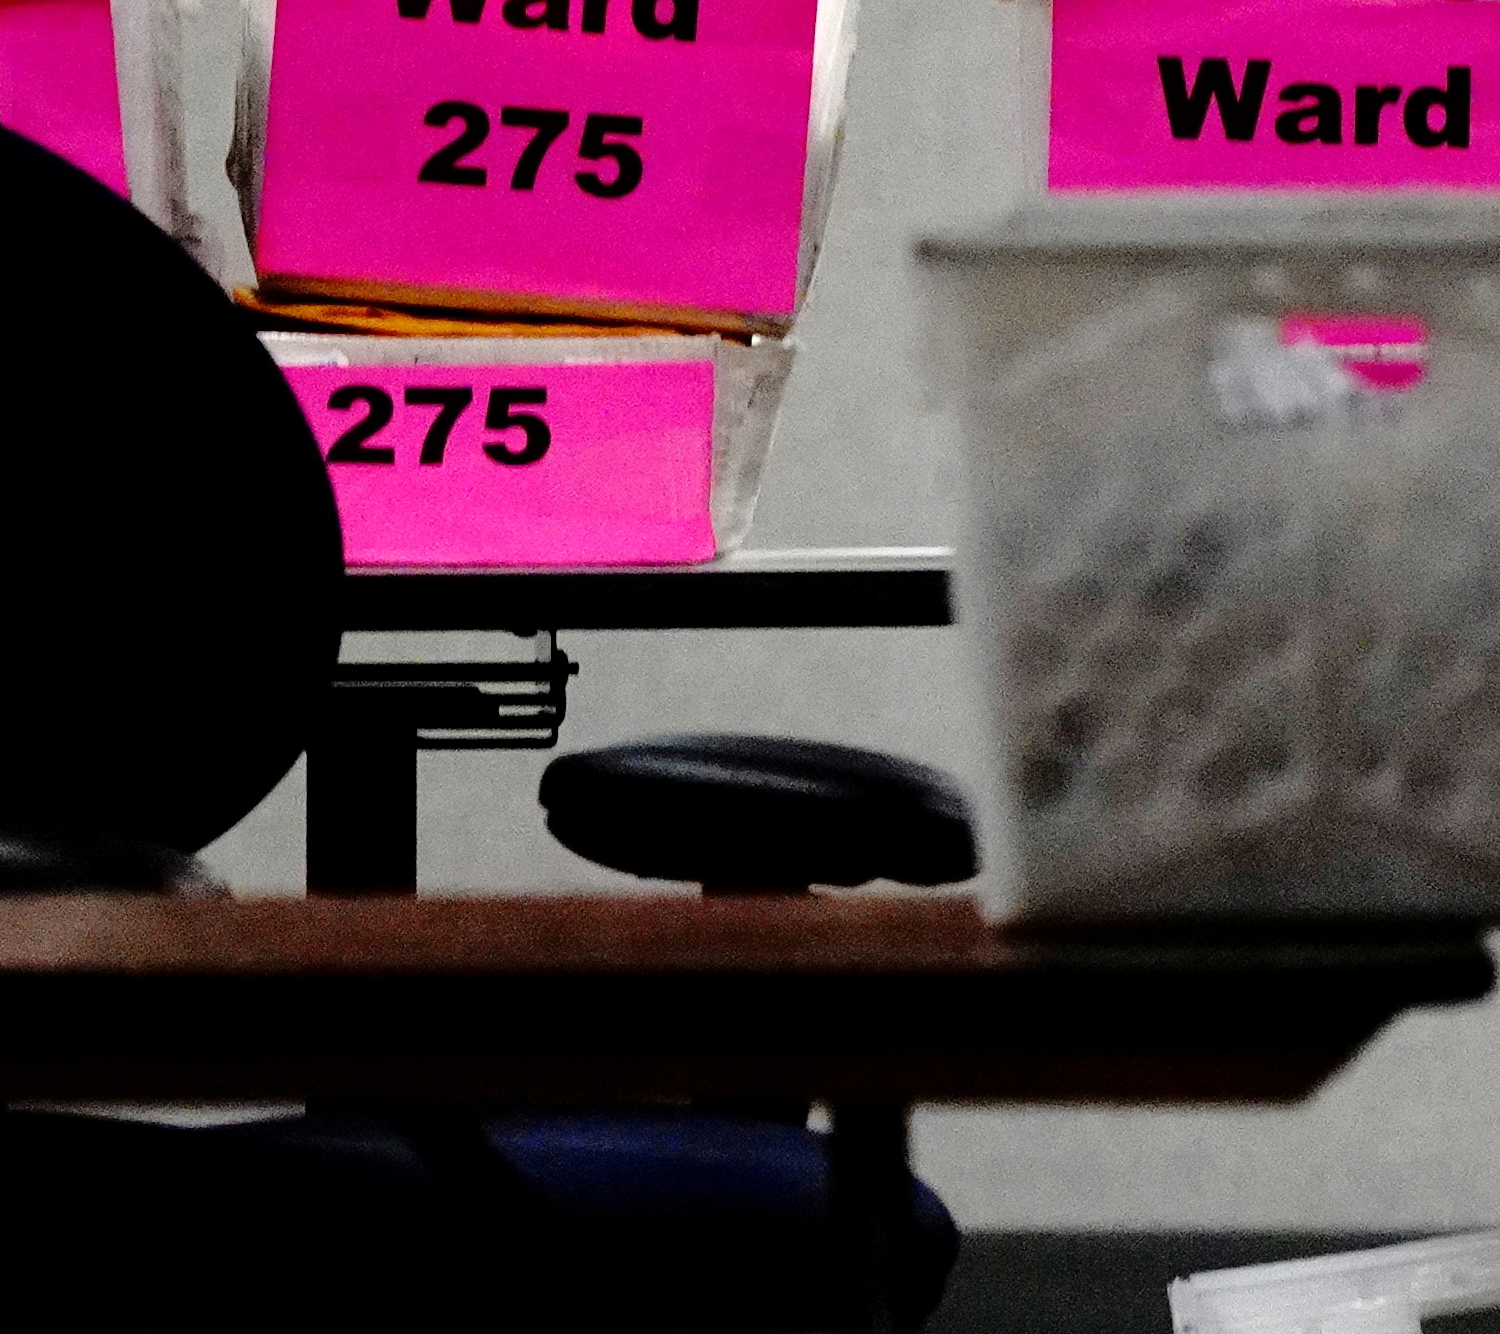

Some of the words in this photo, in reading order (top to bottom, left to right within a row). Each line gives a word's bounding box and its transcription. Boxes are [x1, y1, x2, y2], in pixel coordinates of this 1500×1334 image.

[1158, 57, 1471, 148] Ward
[419, 101, 643, 198] 275
[326, 385, 551, 466] 275
